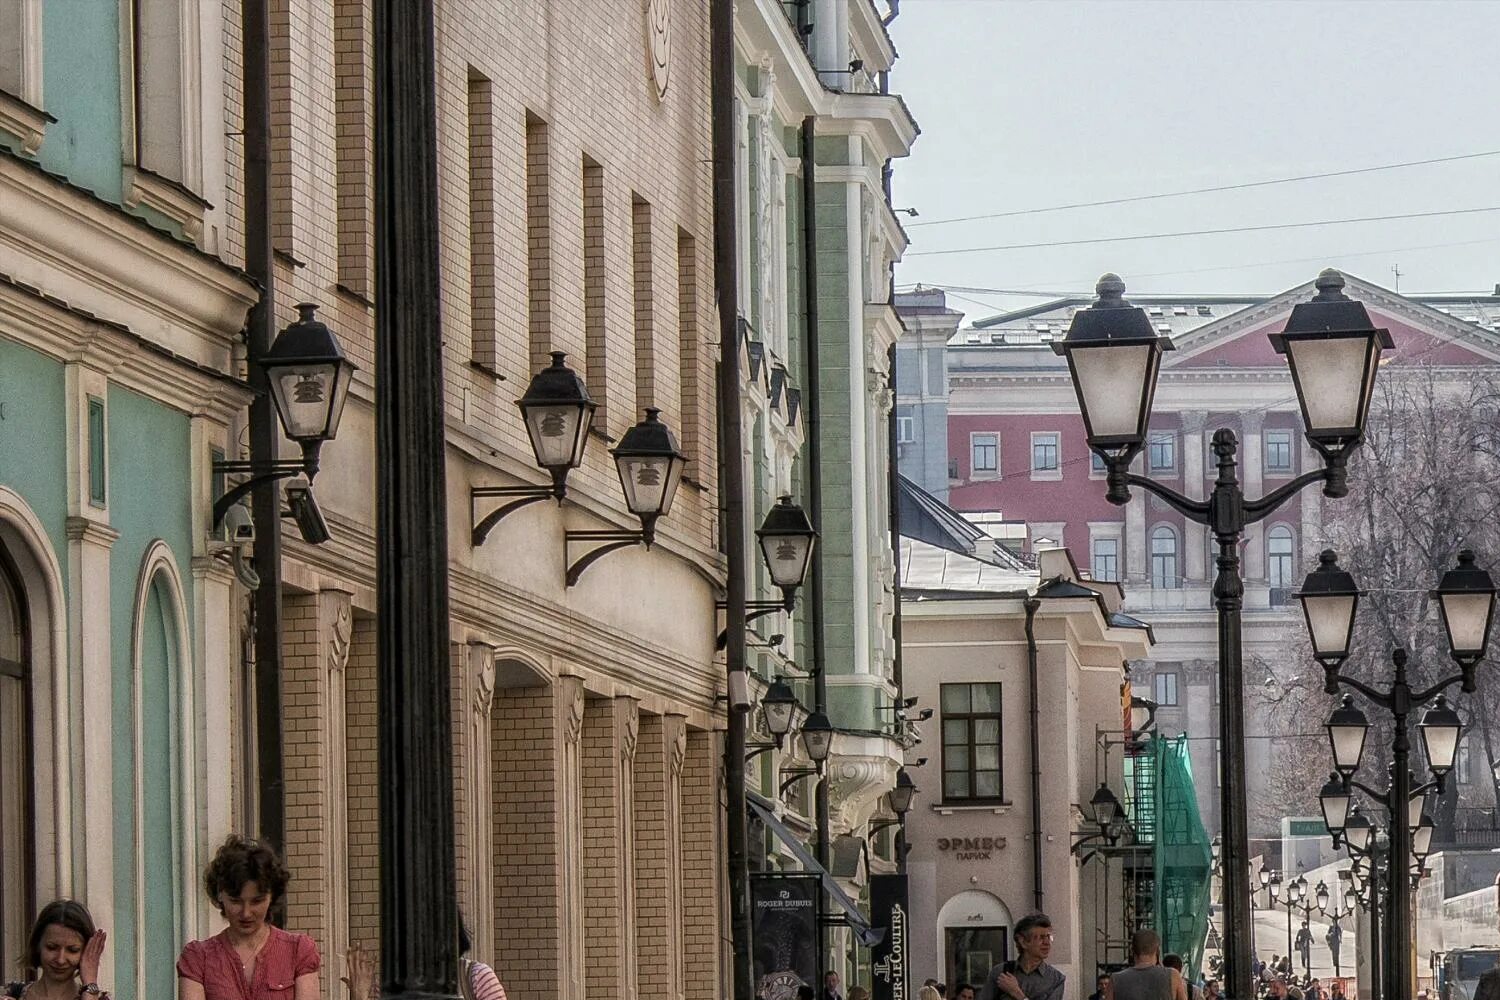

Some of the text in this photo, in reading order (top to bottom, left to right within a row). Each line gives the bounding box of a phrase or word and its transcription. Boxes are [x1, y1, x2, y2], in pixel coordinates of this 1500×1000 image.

[937, 837, 1006, 851] ЭРМЕС
[956, 852, 991, 860] ПАРИЖ
[757, 900, 783, 908] ROGER
